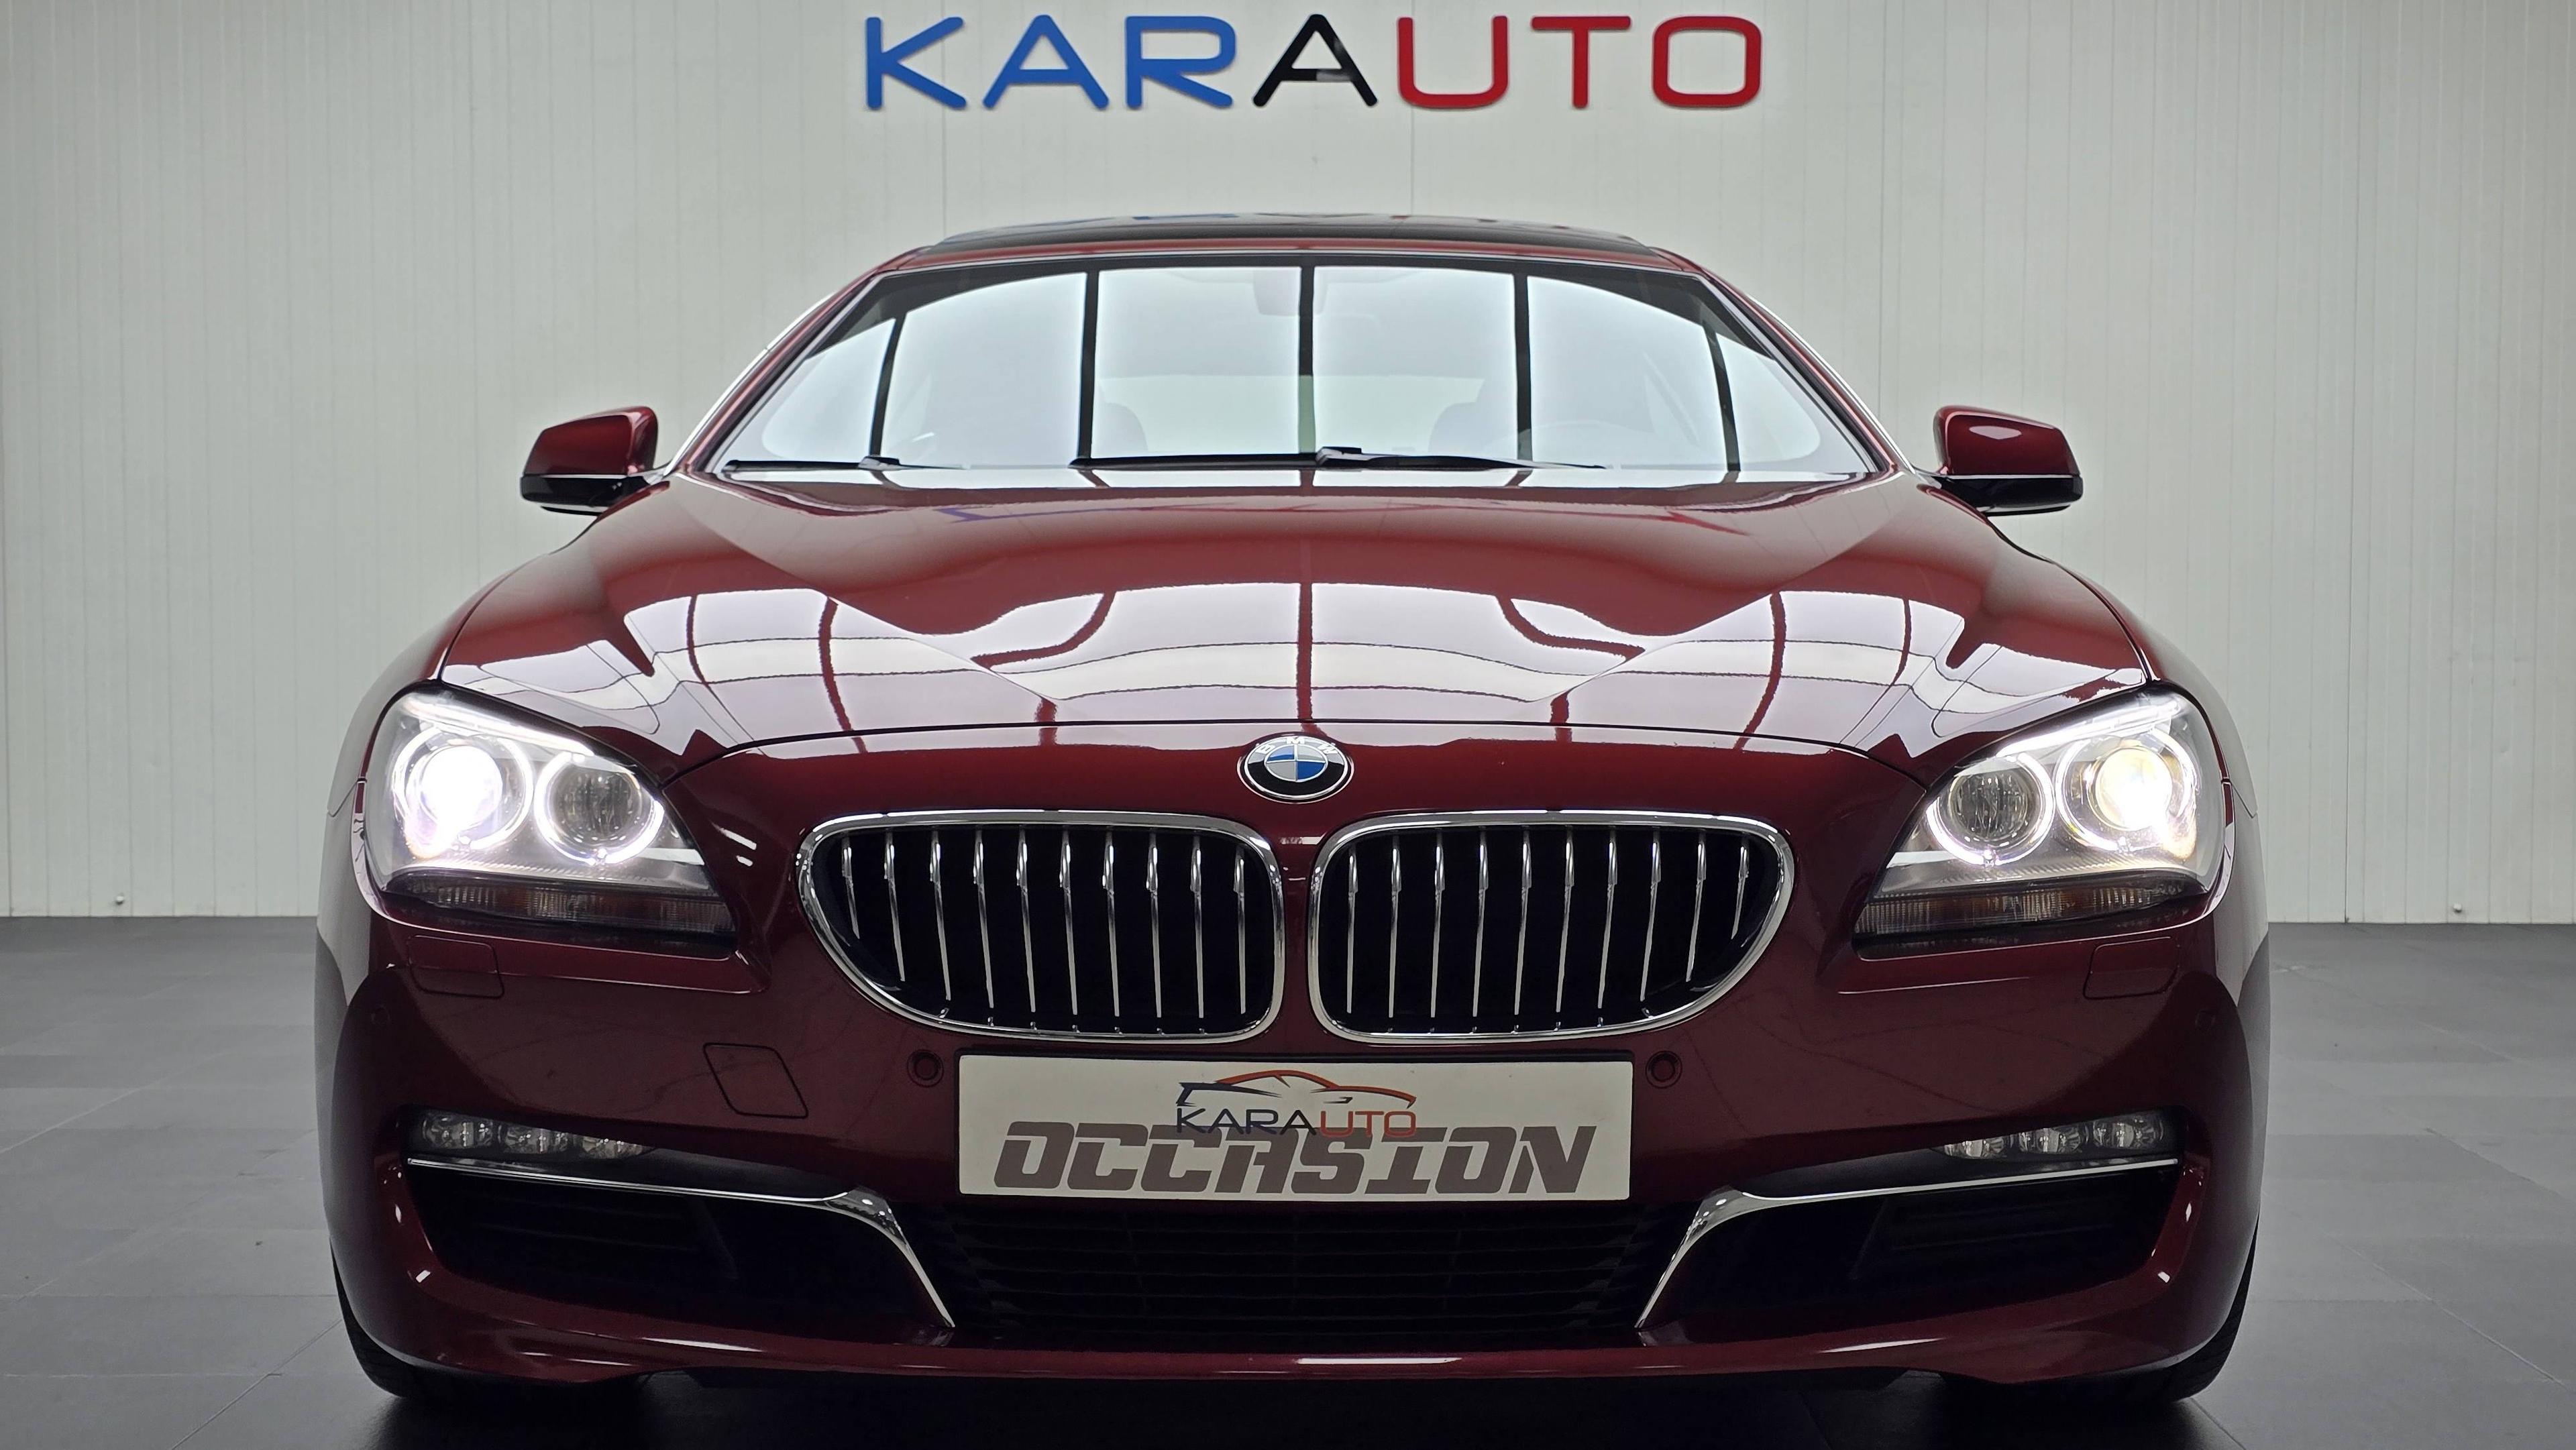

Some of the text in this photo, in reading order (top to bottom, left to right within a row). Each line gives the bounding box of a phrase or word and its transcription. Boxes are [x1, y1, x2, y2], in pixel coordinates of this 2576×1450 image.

[865, 13, 1764, 111] KARAUTO
[1255, 736, 1338, 755] BMW
[1175, 1107, 1417, 1138] KARAUTO
[993, 1121, 1597, 1194] OCCASION
